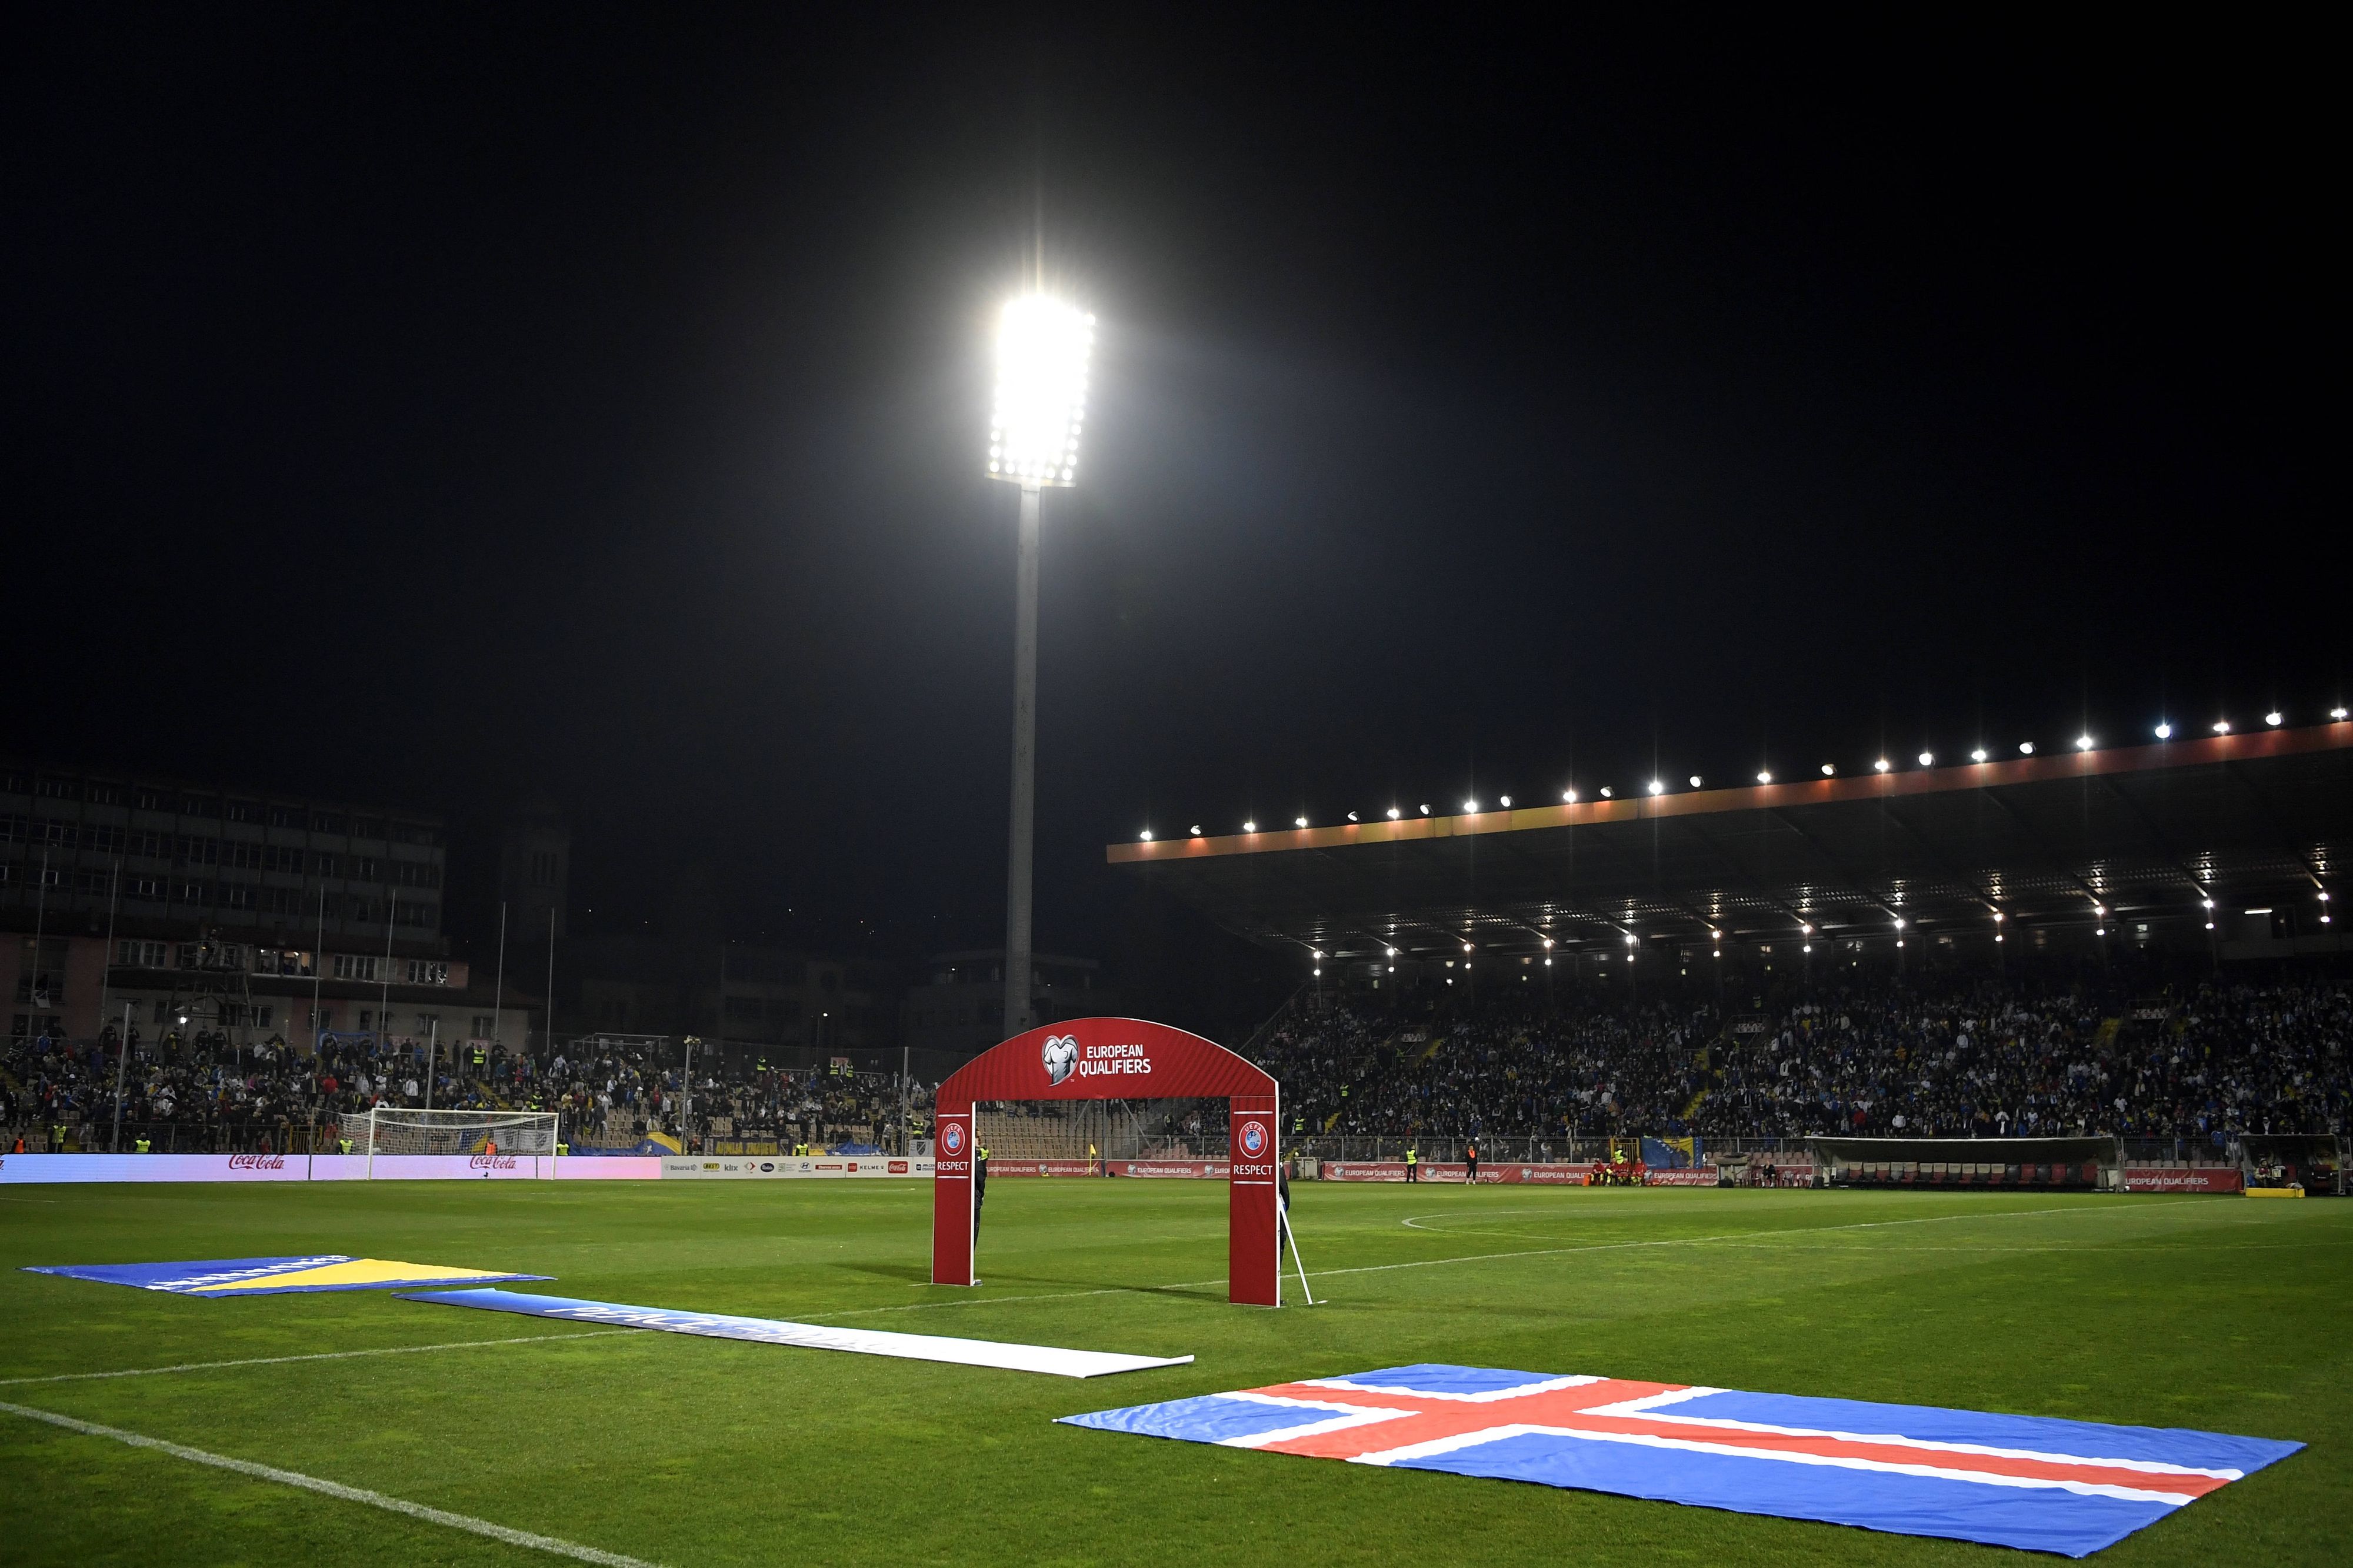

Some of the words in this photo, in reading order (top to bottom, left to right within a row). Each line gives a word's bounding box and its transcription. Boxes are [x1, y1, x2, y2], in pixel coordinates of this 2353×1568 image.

[1086, 1044, 1143, 1059] EUROPEAN
[1079, 1058, 1151, 1077] QUALIFIERS
[1244, 1124, 1262, 1133] UEFA
[228, 1153, 285, 1170] Coca-Cola
[937, 1161, 969, 1170] RESPECT
[1234, 1165, 1273, 1175] RESPECT
[544, 1306, 740, 1329] PEACE
